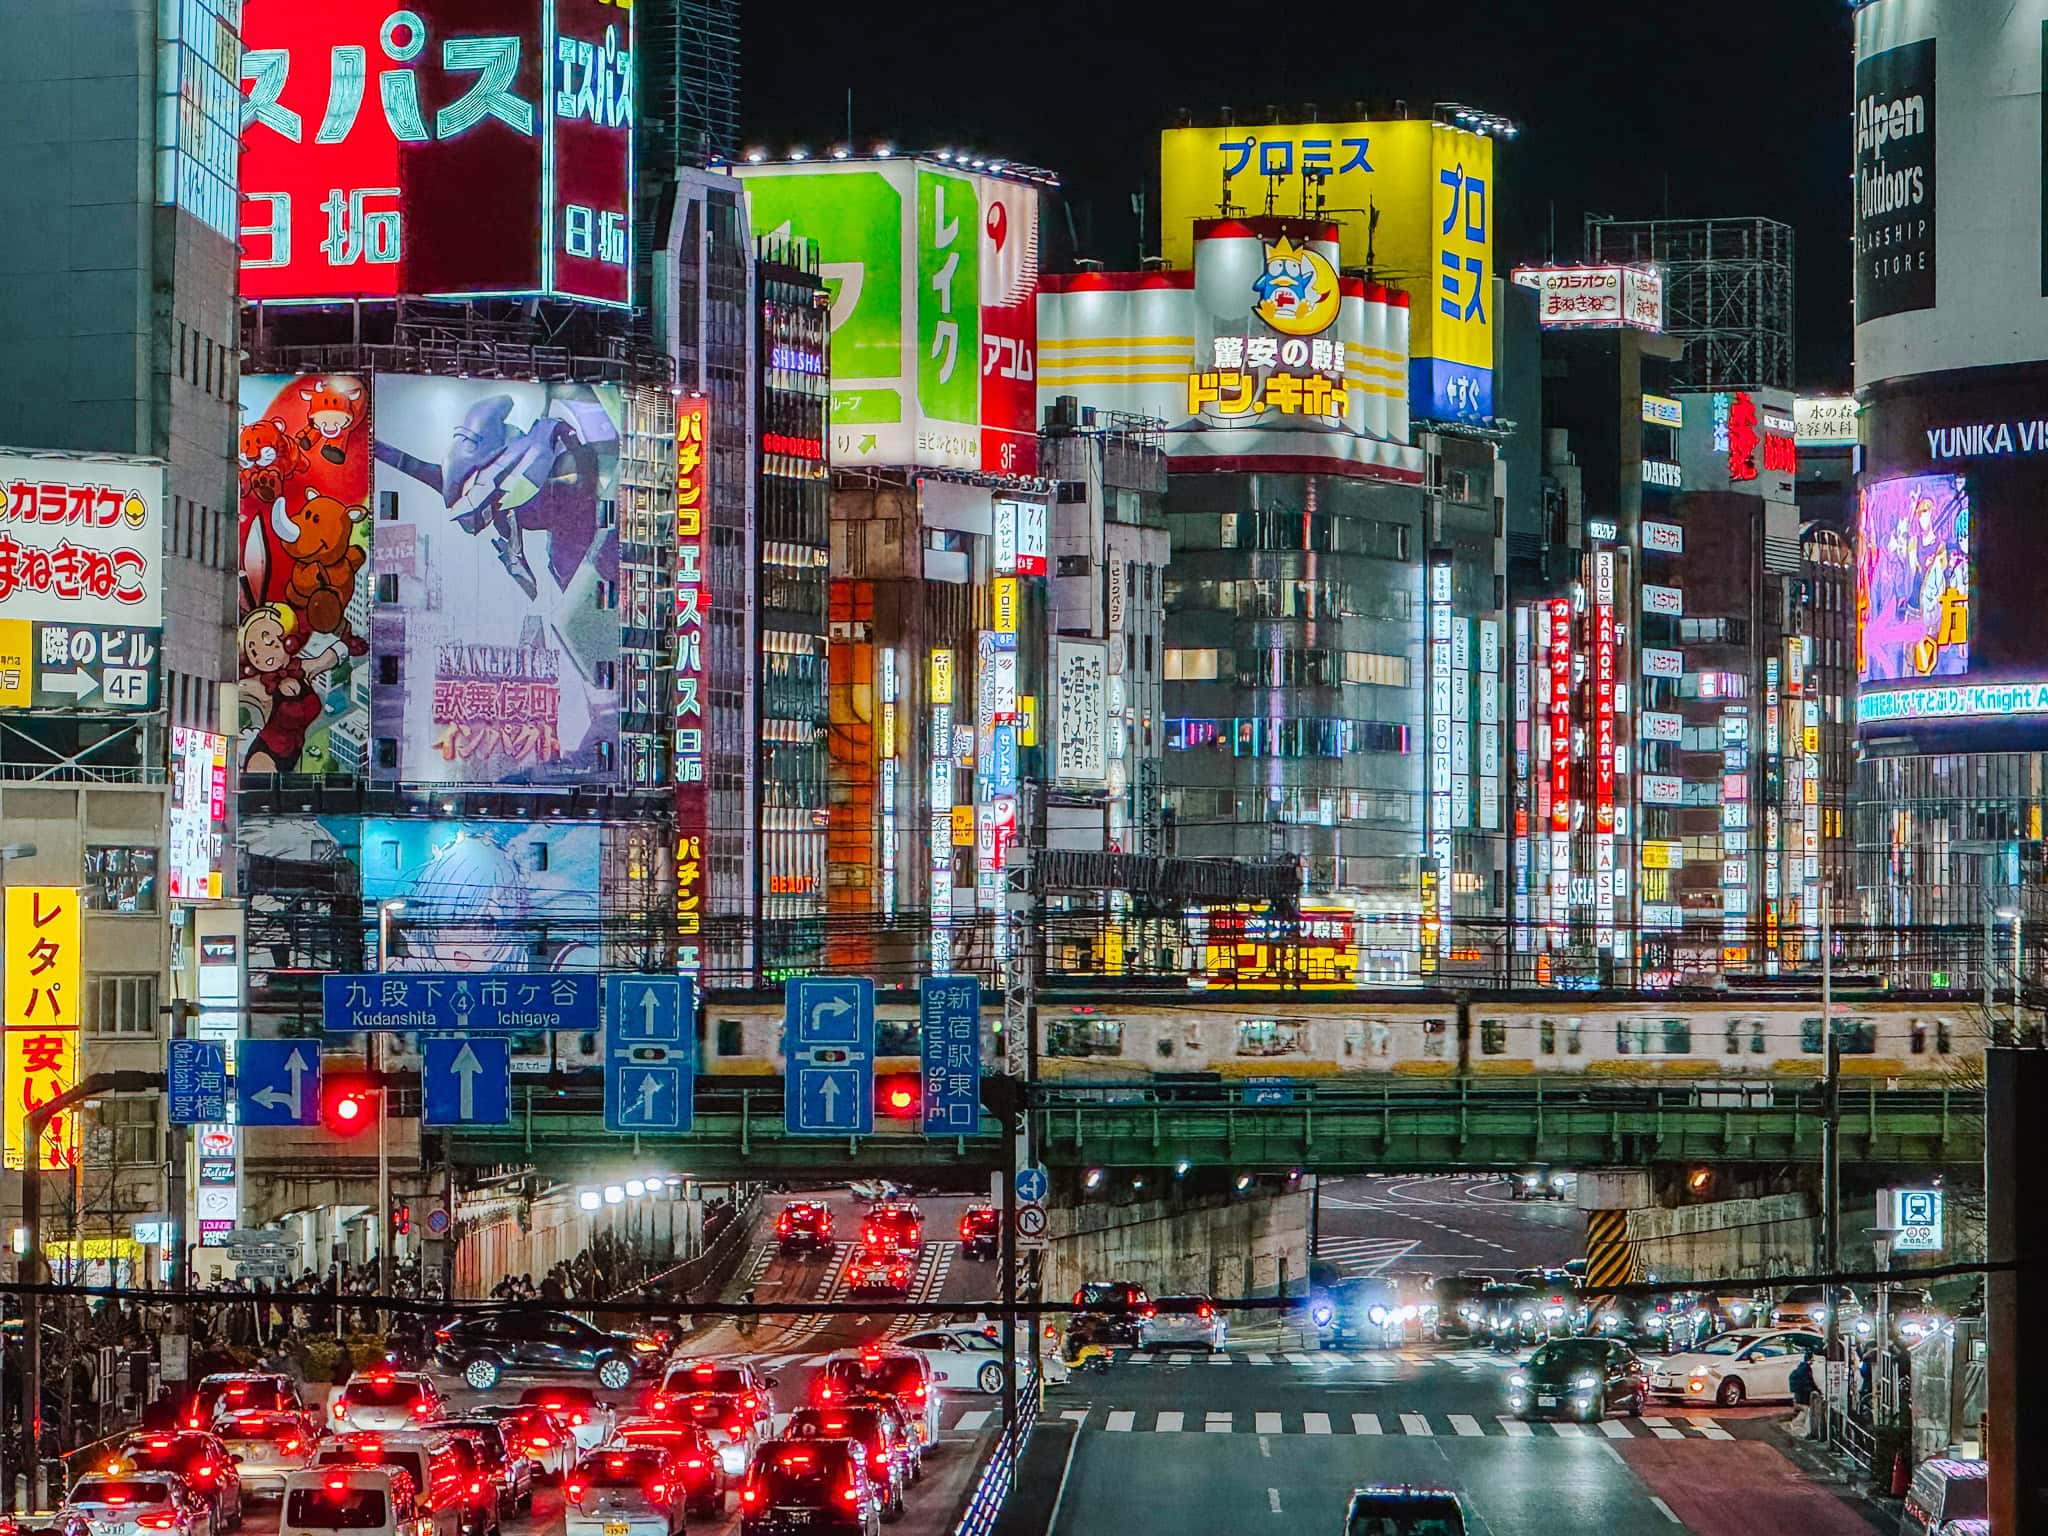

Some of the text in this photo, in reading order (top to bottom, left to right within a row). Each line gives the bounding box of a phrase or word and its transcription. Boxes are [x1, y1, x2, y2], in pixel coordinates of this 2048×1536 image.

[1857, 94, 1925, 160] Alpen
[1219, 137, 1374, 177] プロミス
[1861, 159, 1924, 219] Outdoors
[931, 184, 960, 385] レイク
[1556, 275, 1608, 289] カラオケ
[1874, 251, 1926, 279] STORE
[1547, 295, 1616, 315] まねきねこ
[983, 333, 1034, 382] アコム
[1810, 404, 1853, 420] 水の森
[1000, 442, 1017, 469] 3F
[1927, 422, 2012, 460] YUNIKA
[677, 413, 703, 536] パチンコ
[9, 481, 125, 526] カラオケ
[41, 626, 154, 668] 隣のビル
[1600, 605, 1612, 696] KARAOKE
[109, 673, 142, 699] 4F
[432, 720, 561, 761] インパクト
[1600, 720, 1612, 783] PARTY
[677, 836, 700, 935] パチンコ
[1600, 840, 1612, 943] PASELA
[27, 892, 63, 1017] レタパ
[345, 980, 446, 1008] 九段下
[352, 1010, 437, 1026] Kudanshita
[498, 1010, 560, 1028] Ichigaya
[927, 989, 946, 1060] Shinjuku
[947, 985, 973, 1125] 新宿駅東口
[194, 1044, 222, 1119] 小滝橋
